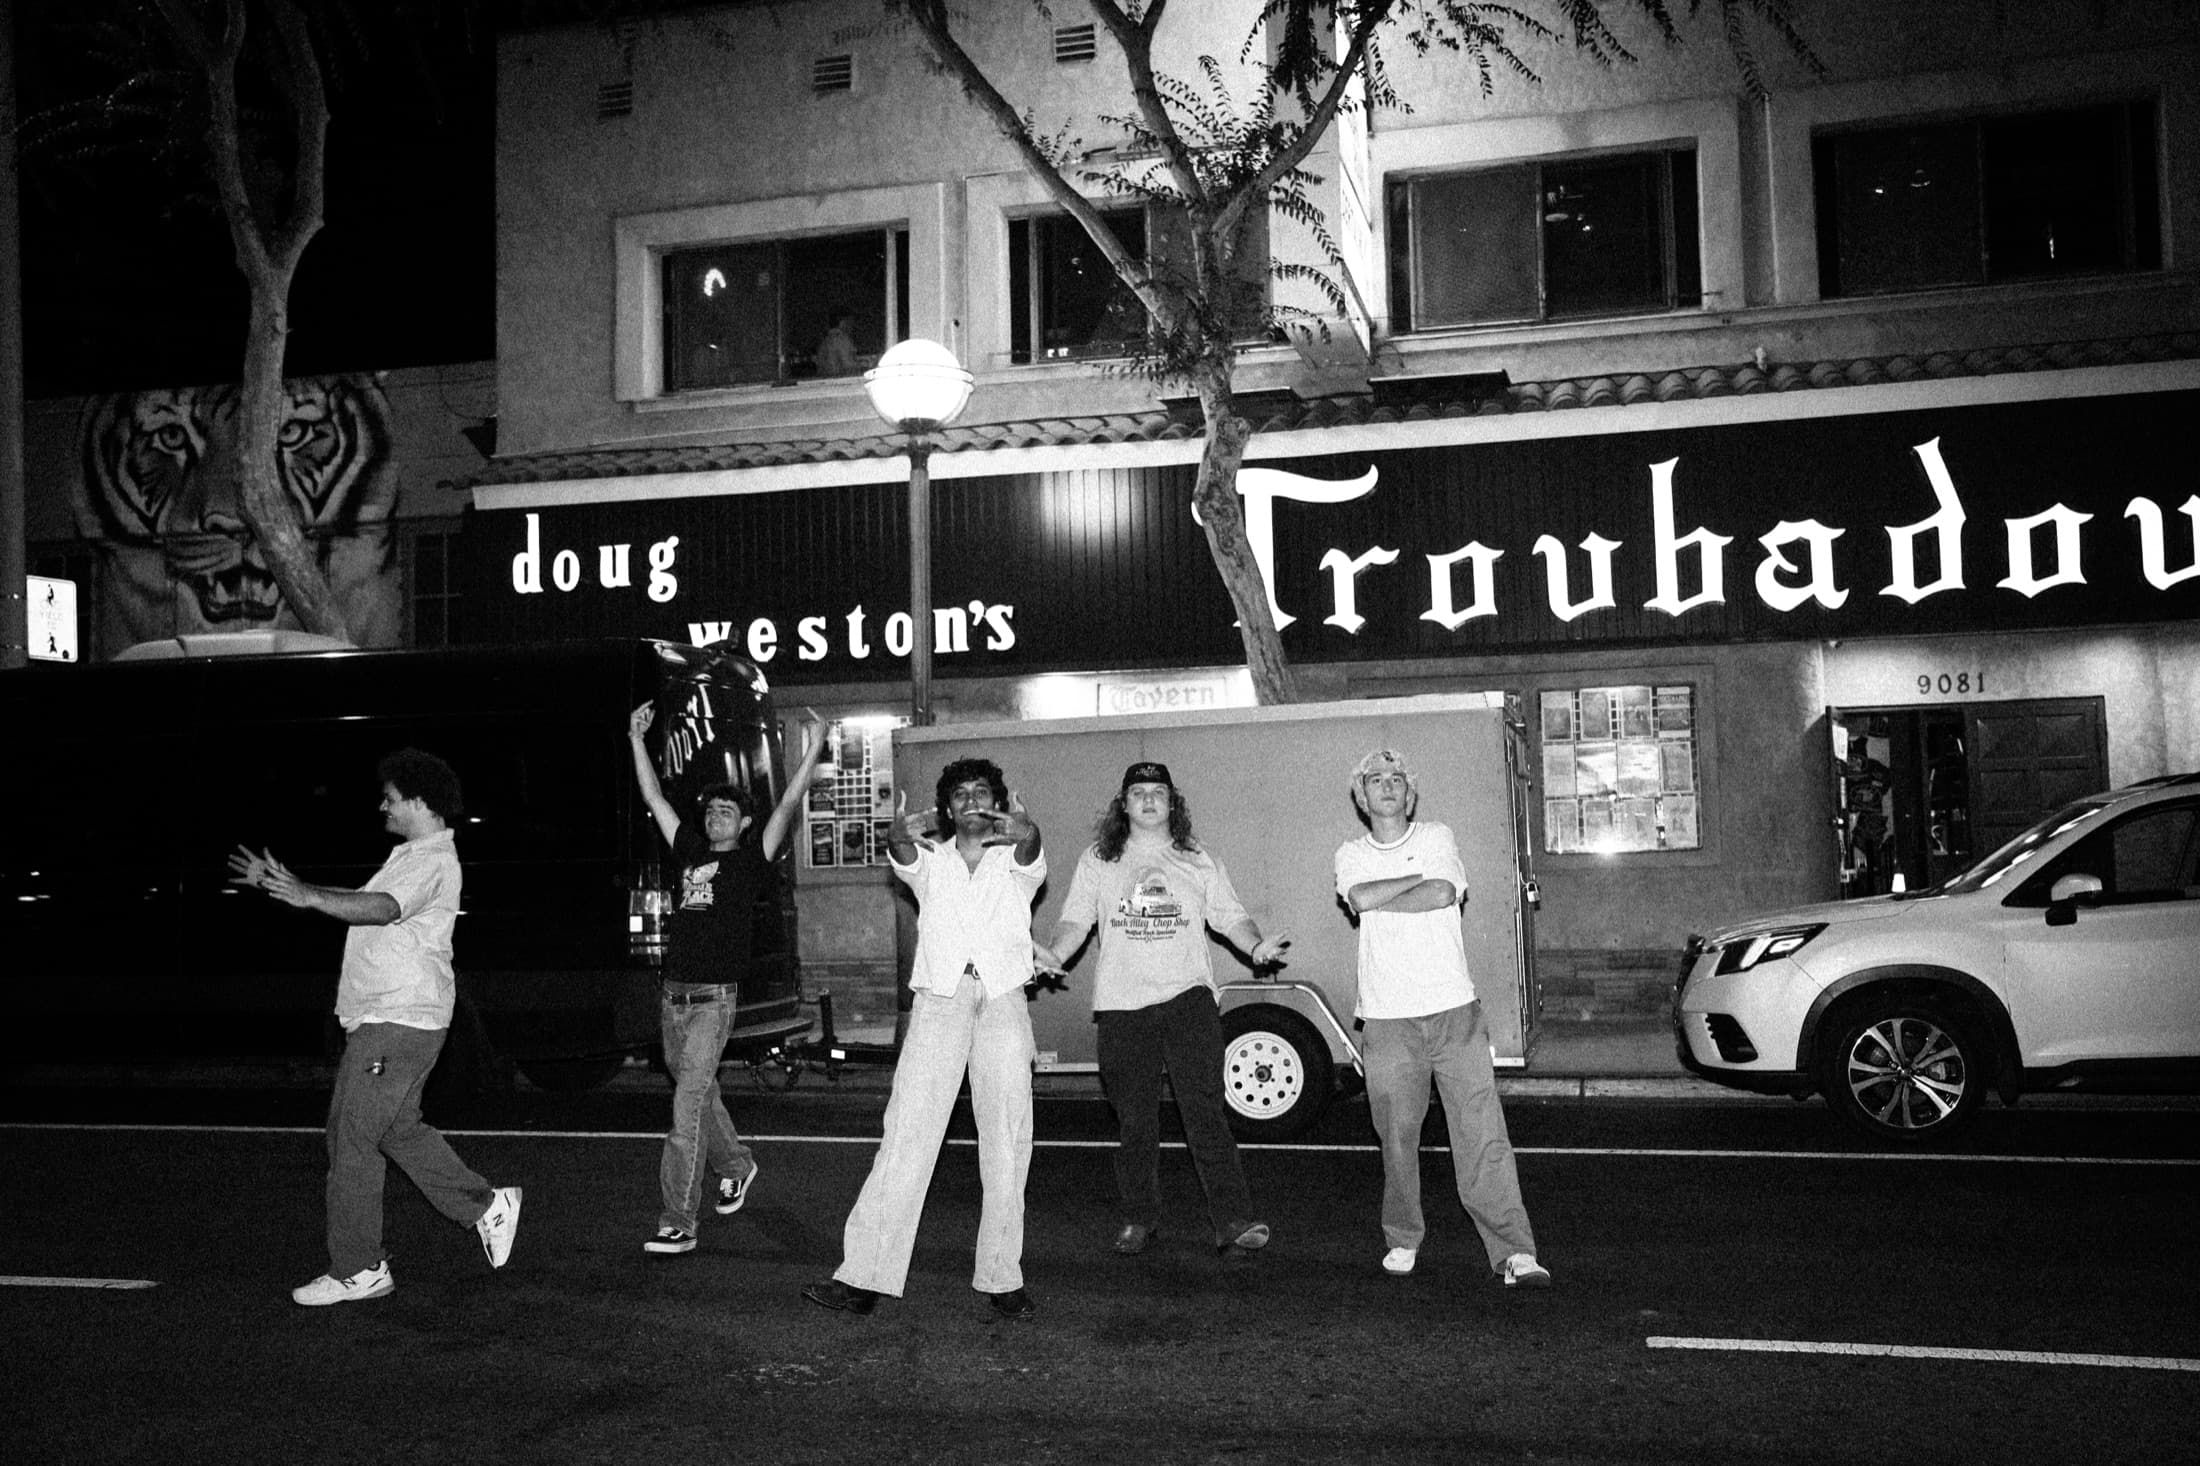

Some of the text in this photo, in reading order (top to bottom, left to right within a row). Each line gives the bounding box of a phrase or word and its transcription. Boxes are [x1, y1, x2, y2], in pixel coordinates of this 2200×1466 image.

[512, 514, 678, 601] doug
[688, 601, 1016, 661] weston's
[1917, 671, 1985, 695] 9081
[1109, 684, 1214, 712] Tavern
[1153, 918, 1172, 929] Chop
